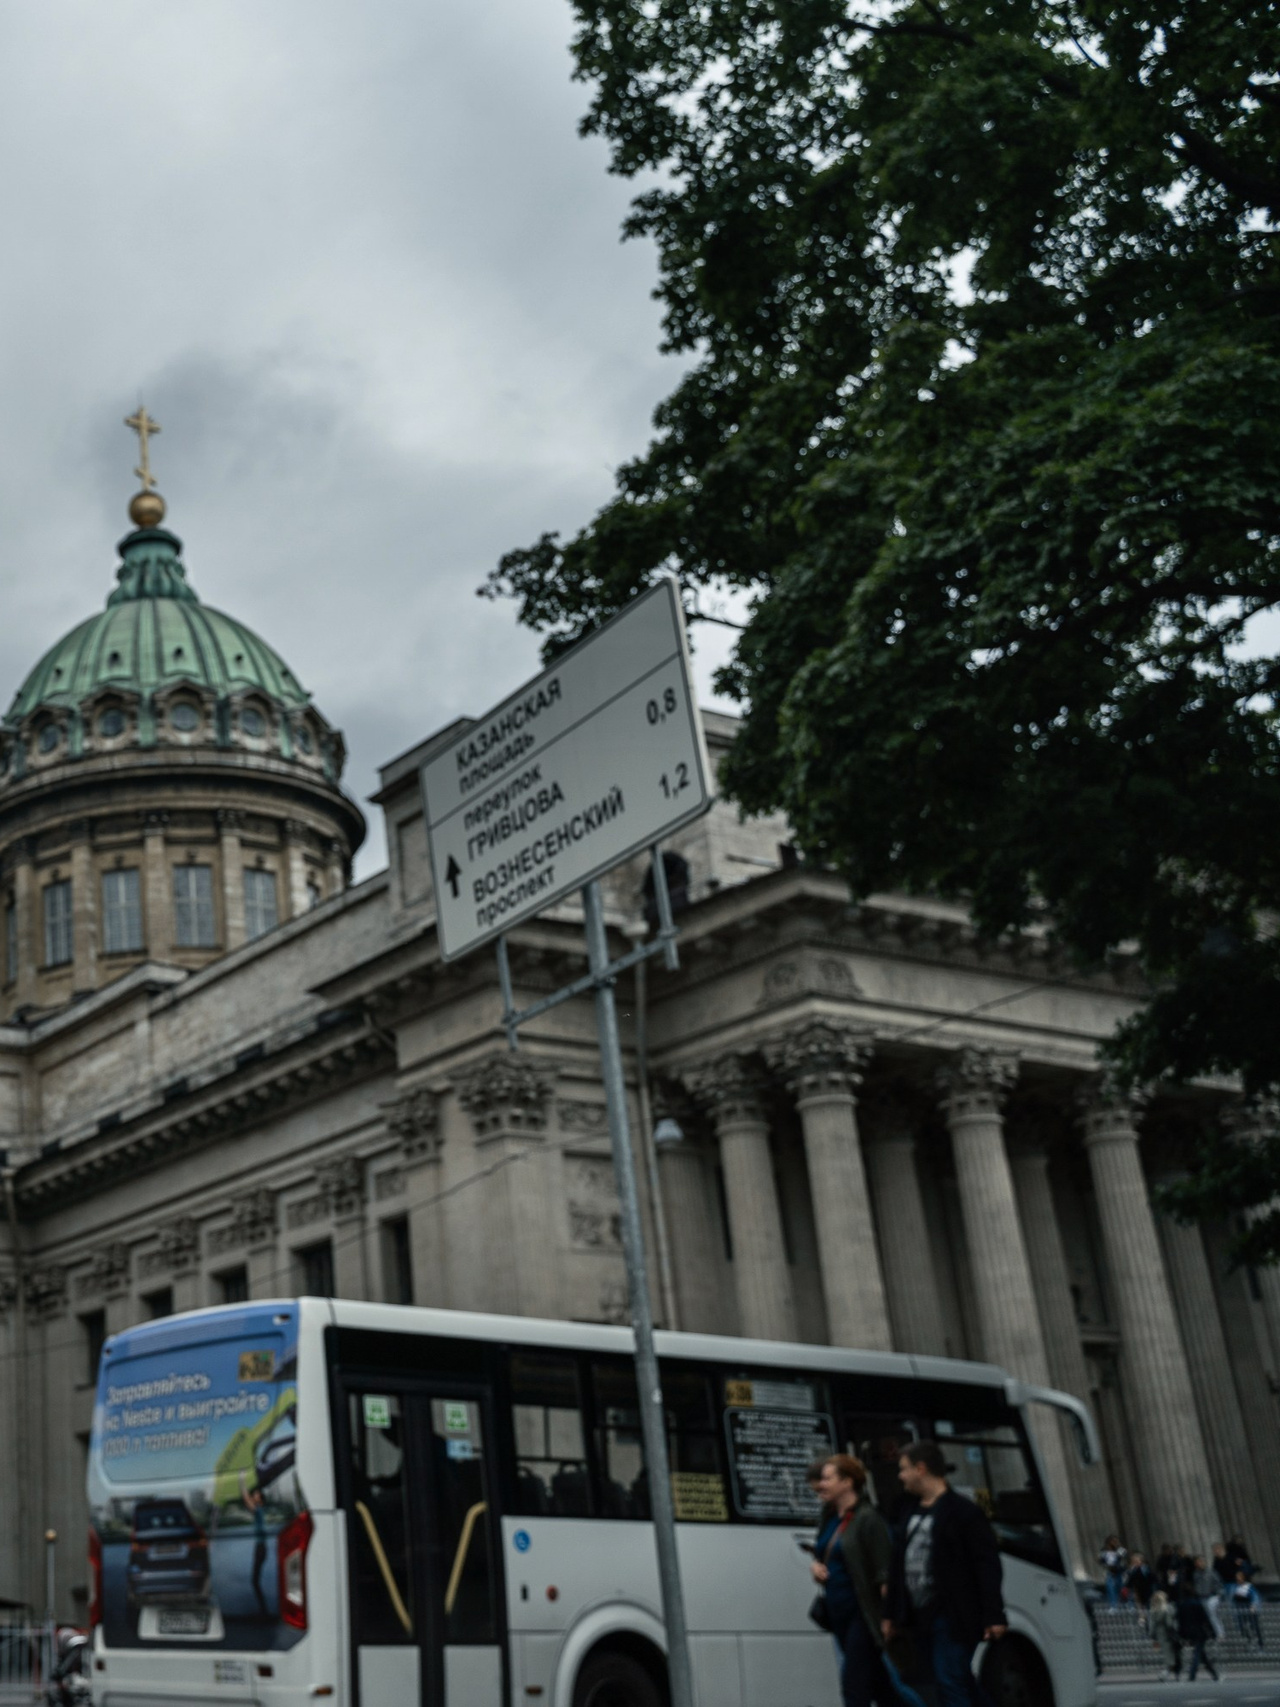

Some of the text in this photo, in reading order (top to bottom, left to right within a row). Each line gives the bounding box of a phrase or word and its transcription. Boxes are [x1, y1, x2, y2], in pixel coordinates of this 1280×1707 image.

[456, 677, 562, 773] КАЗАНСКАЯ
[460, 733, 535, 795] площадь
[464, 763, 542, 831] переулок
[468, 686, 677, 862] ГРИВЦОВА 0,8
[473, 761, 691, 903] ВОЗНЕСЕНСКИЙ 1,2
[477, 864, 555, 928] проспект
[177, 1390, 269, 1423] выиграйте
